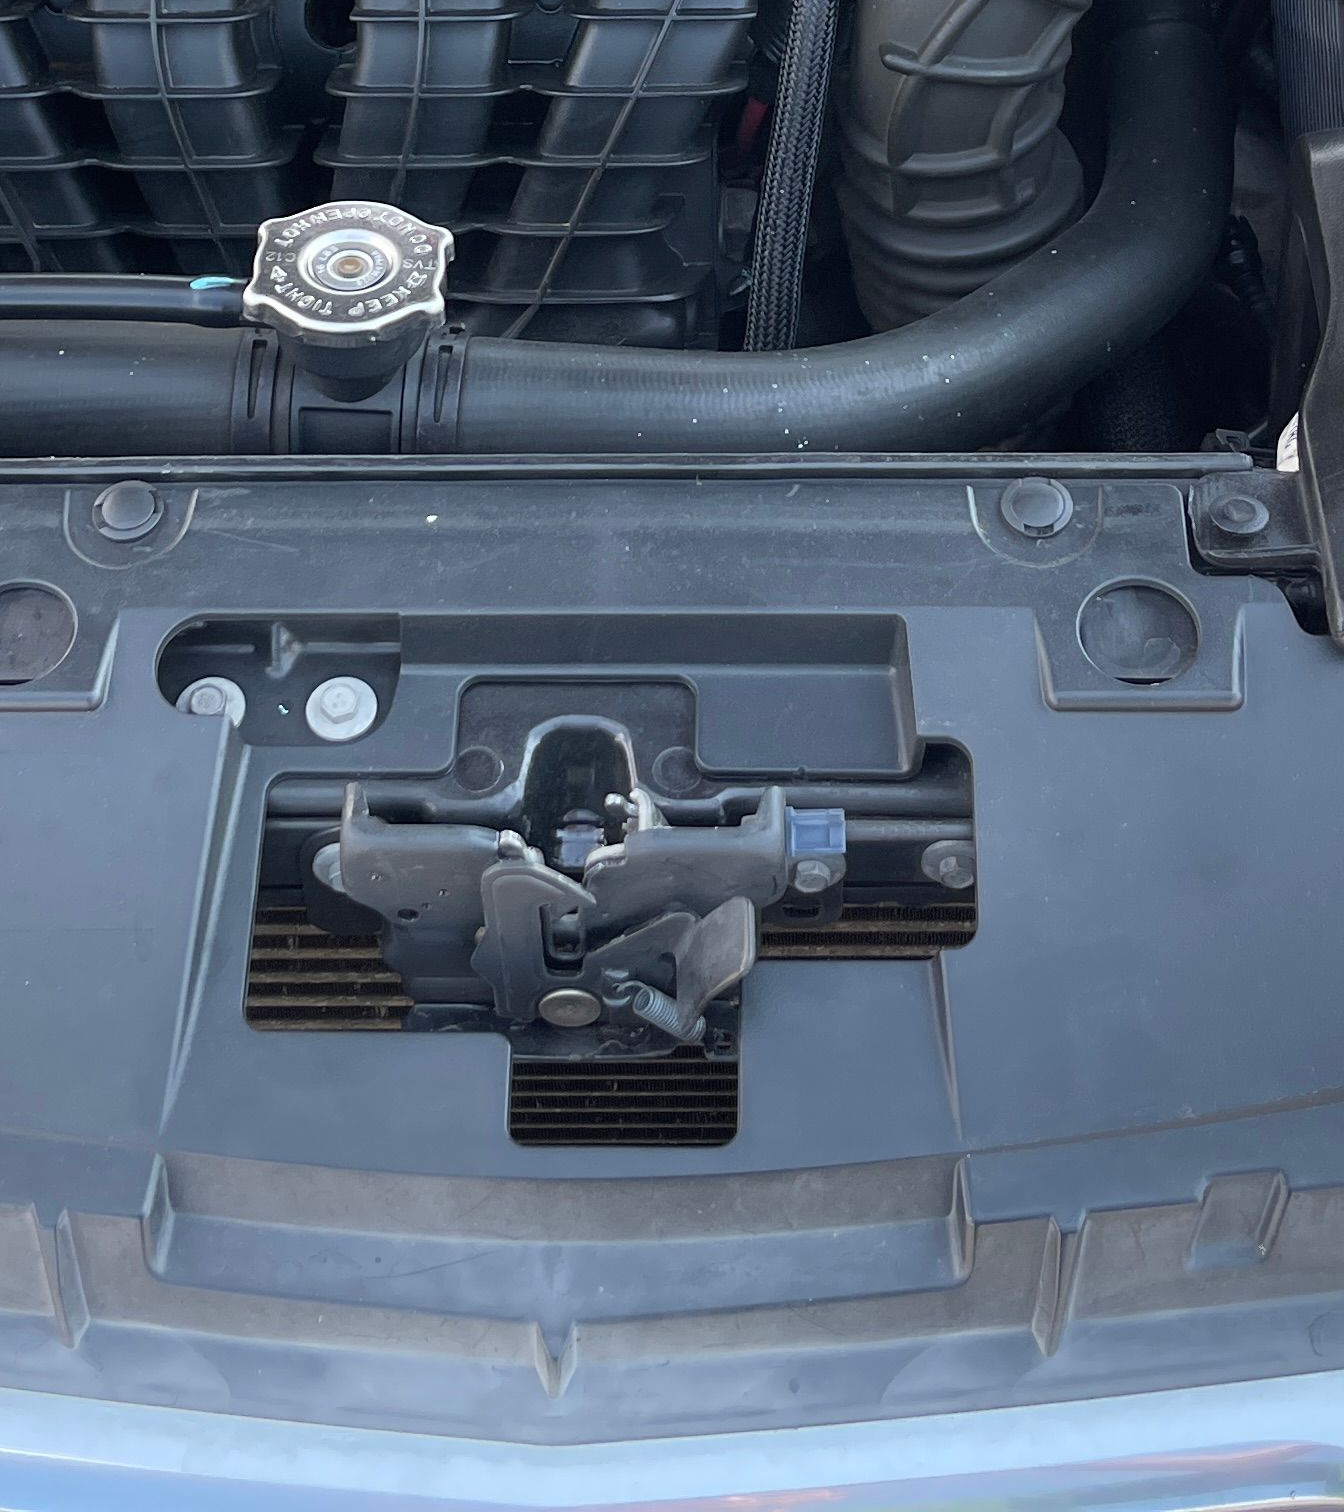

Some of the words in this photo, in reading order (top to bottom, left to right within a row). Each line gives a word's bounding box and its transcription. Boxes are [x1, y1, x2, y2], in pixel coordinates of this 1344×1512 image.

[310, 207, 371, 224] OPEN
[372, 211, 417, 237] NOT
[274, 219, 311, 248] HOT
[409, 234, 432, 254] DO
[265, 251, 297, 263] C12
[402, 258, 436, 270] TVS
[274, 281, 334, 316] TIGHT
[347, 285, 411, 317] KEEP
